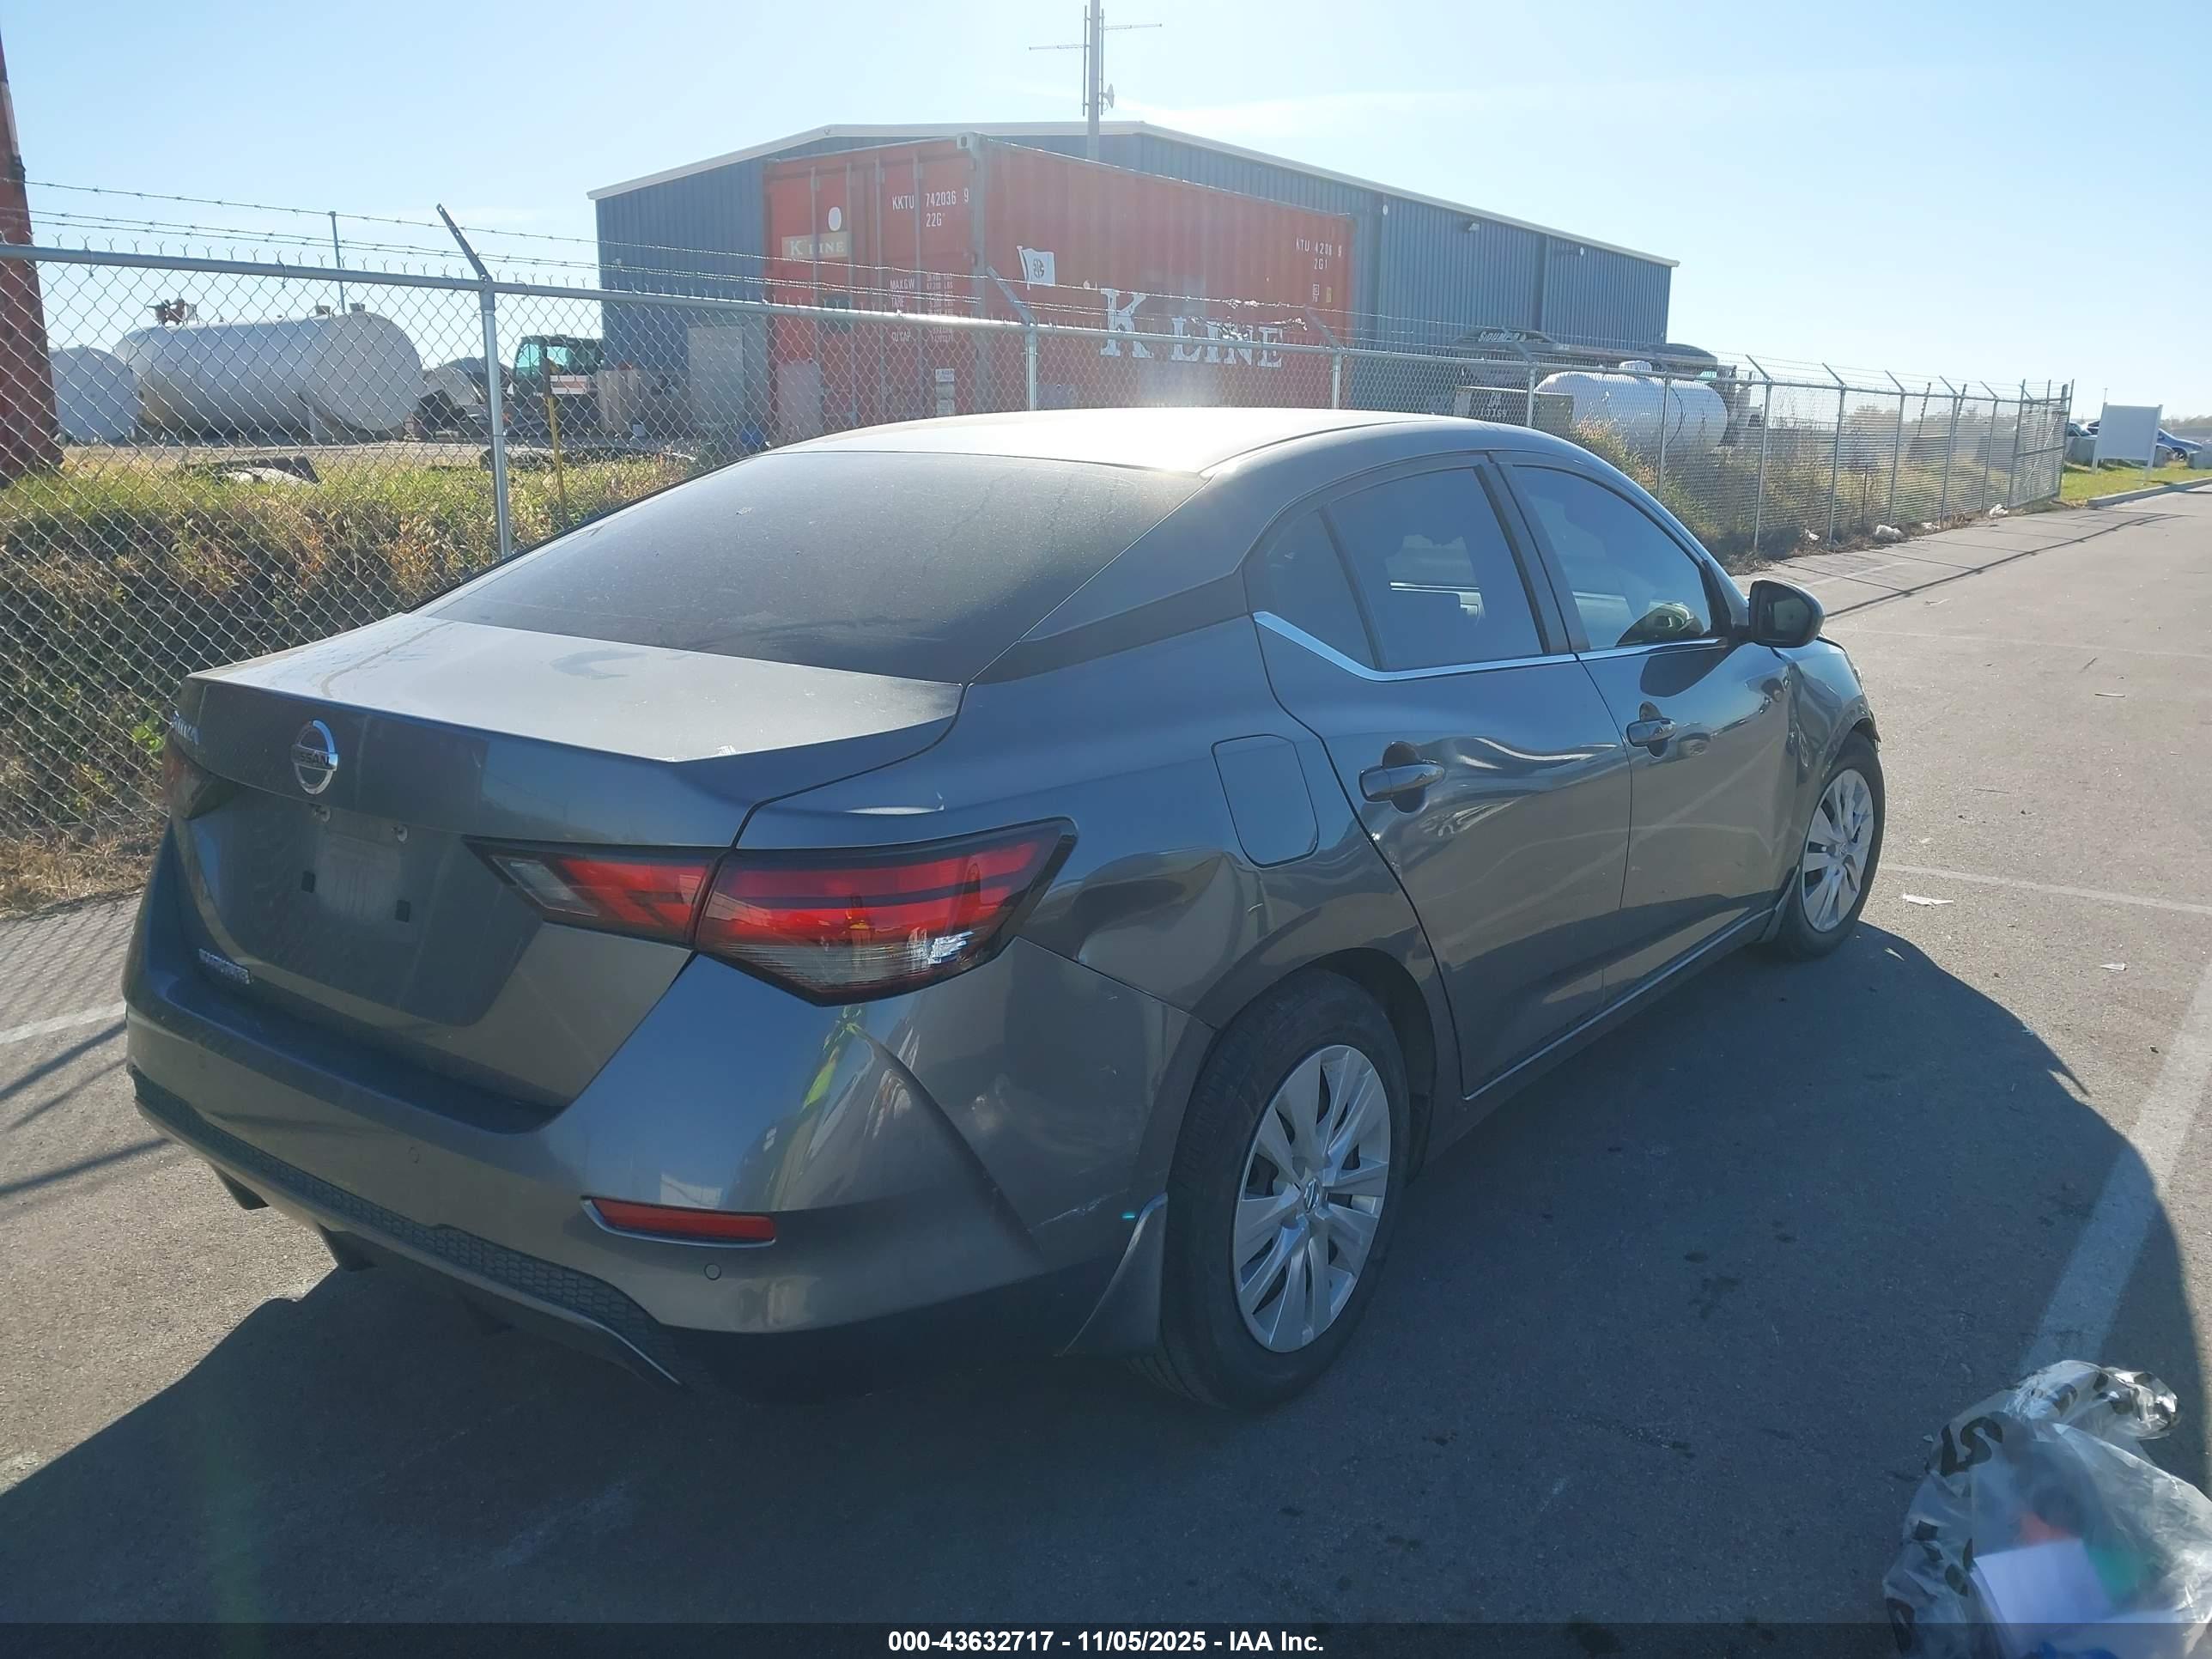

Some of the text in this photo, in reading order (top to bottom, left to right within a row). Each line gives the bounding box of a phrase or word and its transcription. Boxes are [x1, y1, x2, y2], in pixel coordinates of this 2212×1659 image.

[892, 187, 969, 210] KKTU 742036 9
[1099, 288, 1284, 368] K LINE
